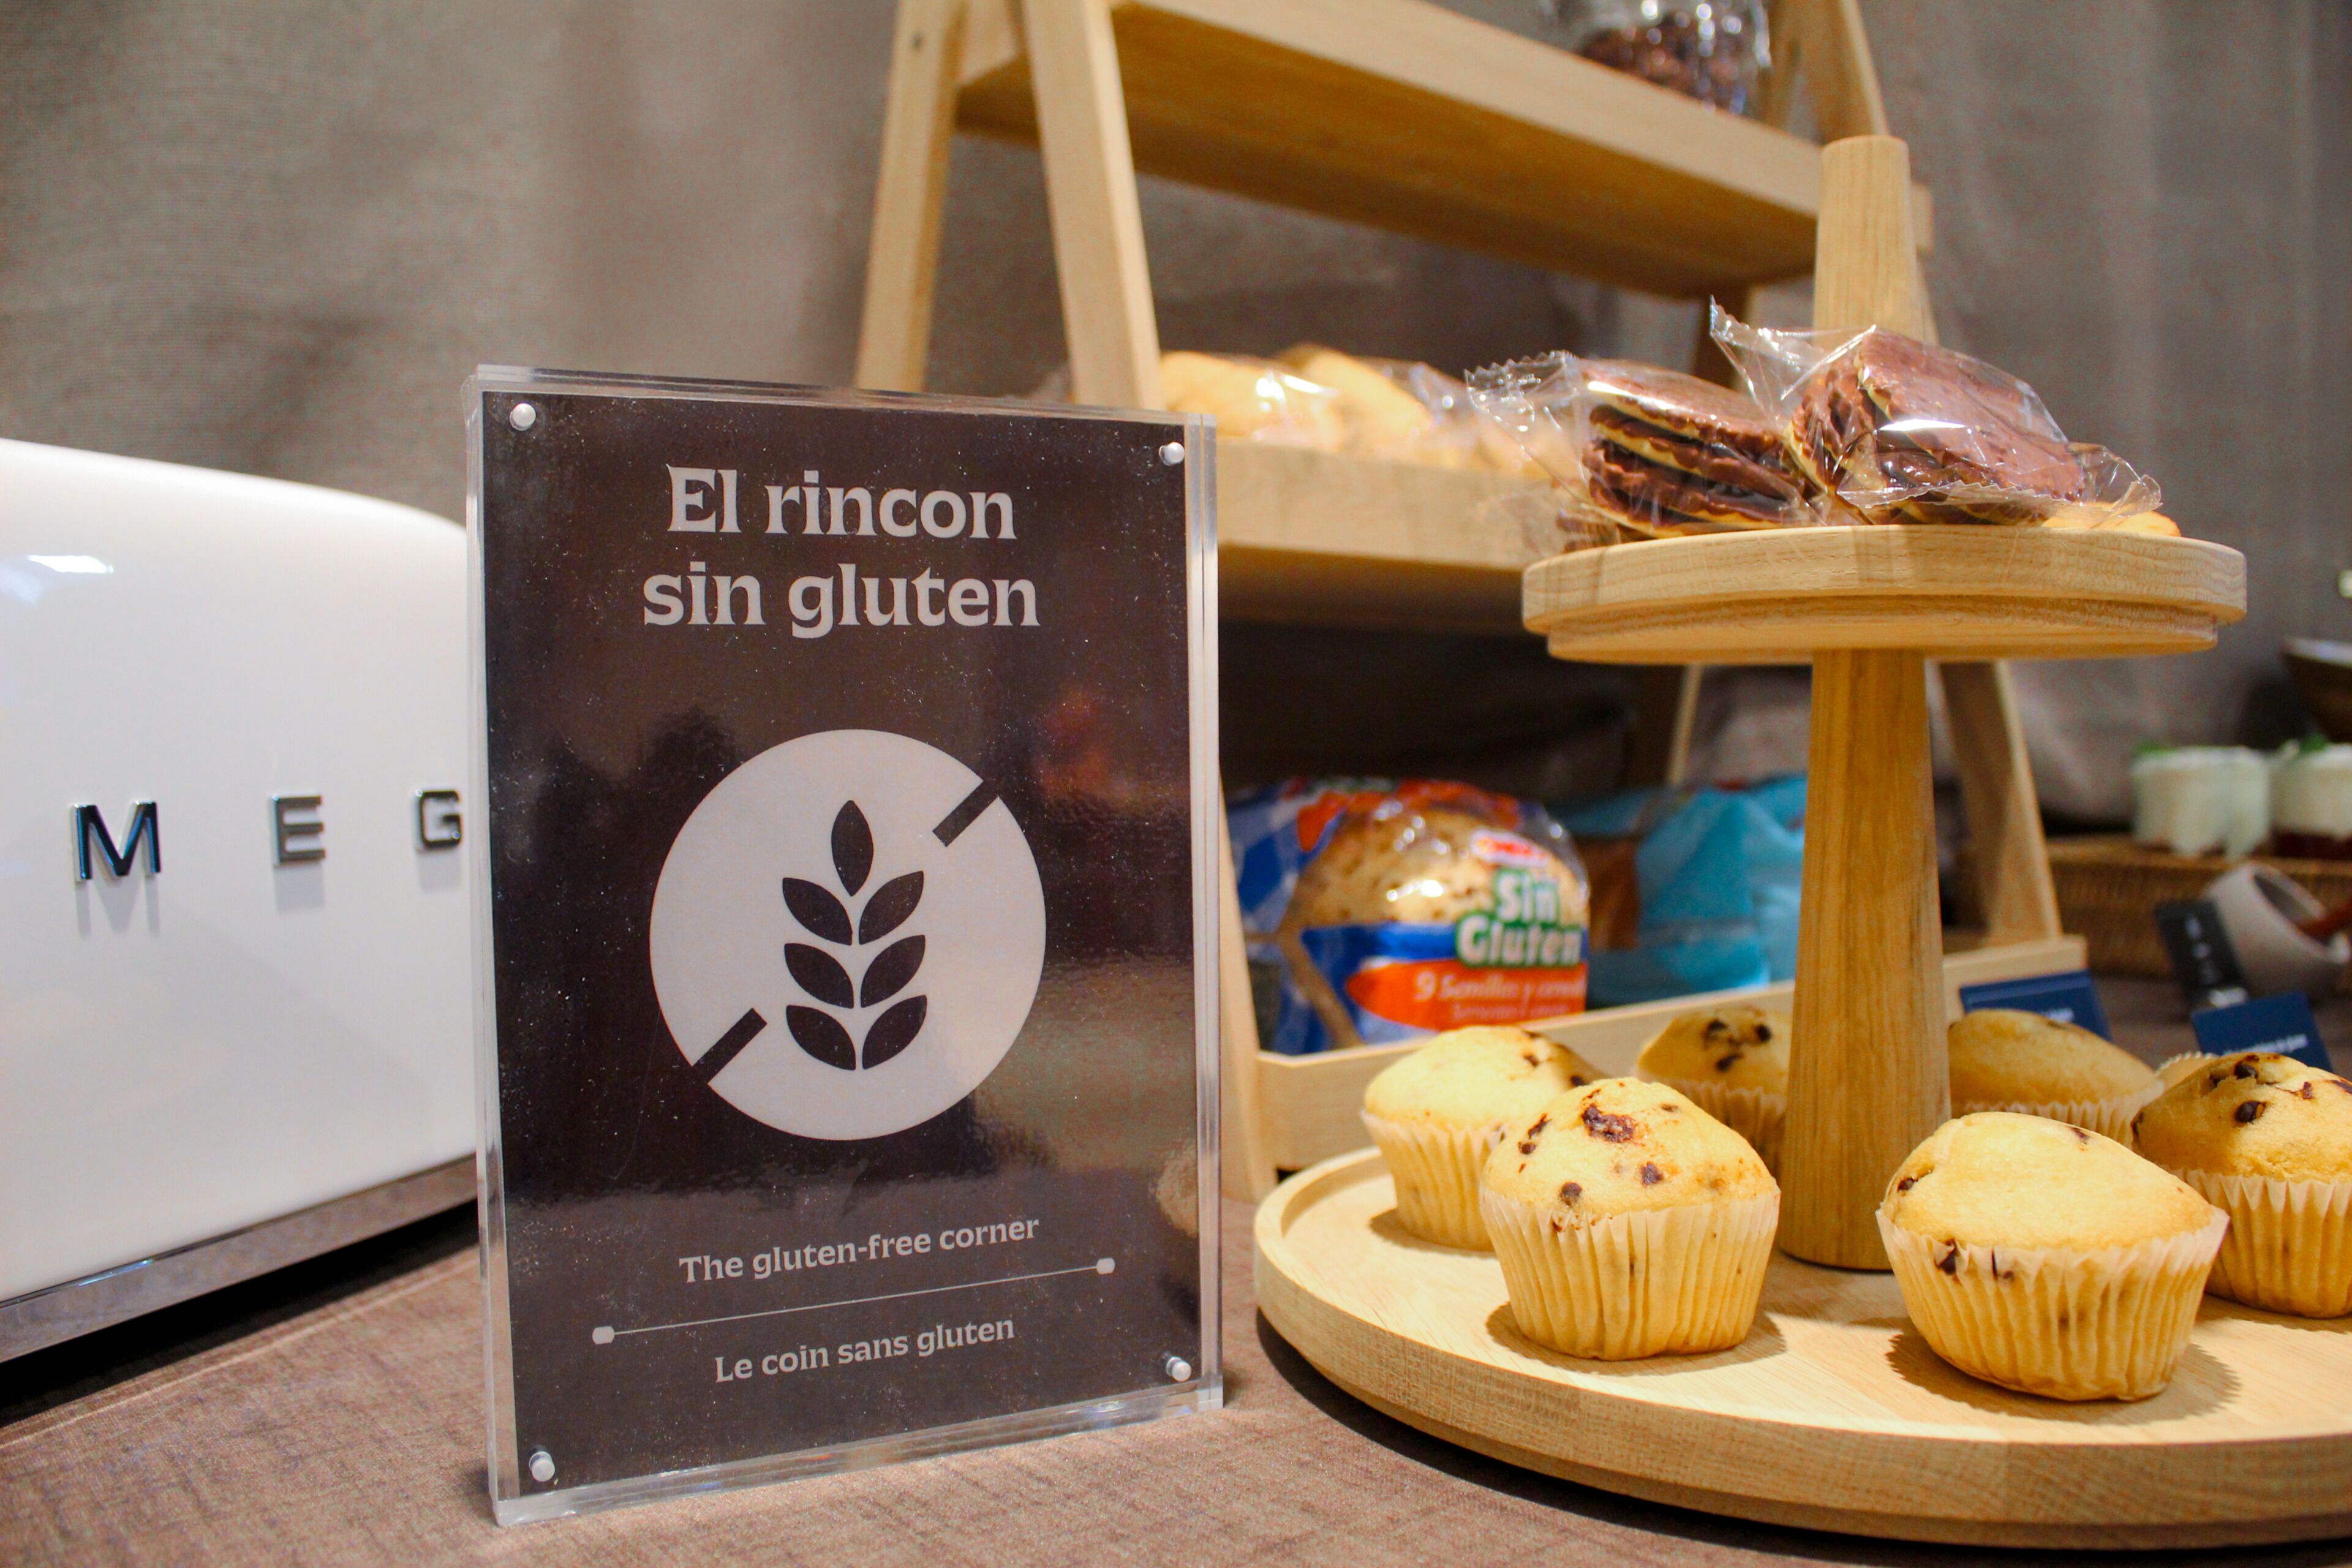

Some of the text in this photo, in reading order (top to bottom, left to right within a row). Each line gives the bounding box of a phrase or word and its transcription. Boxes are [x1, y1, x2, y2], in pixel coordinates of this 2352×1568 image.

[666, 464, 1017, 539] El rincon
[643, 561, 1040, 639] sin gluten
[1495, 870, 1558, 922] Sin
[1458, 913, 1581, 965] Gluten
[1413, 970, 1437, 1001] 9
[678, 1219, 1039, 1283] The gluten-free corner
[715, 1319, 1014, 1382] Le coin sans gluten
